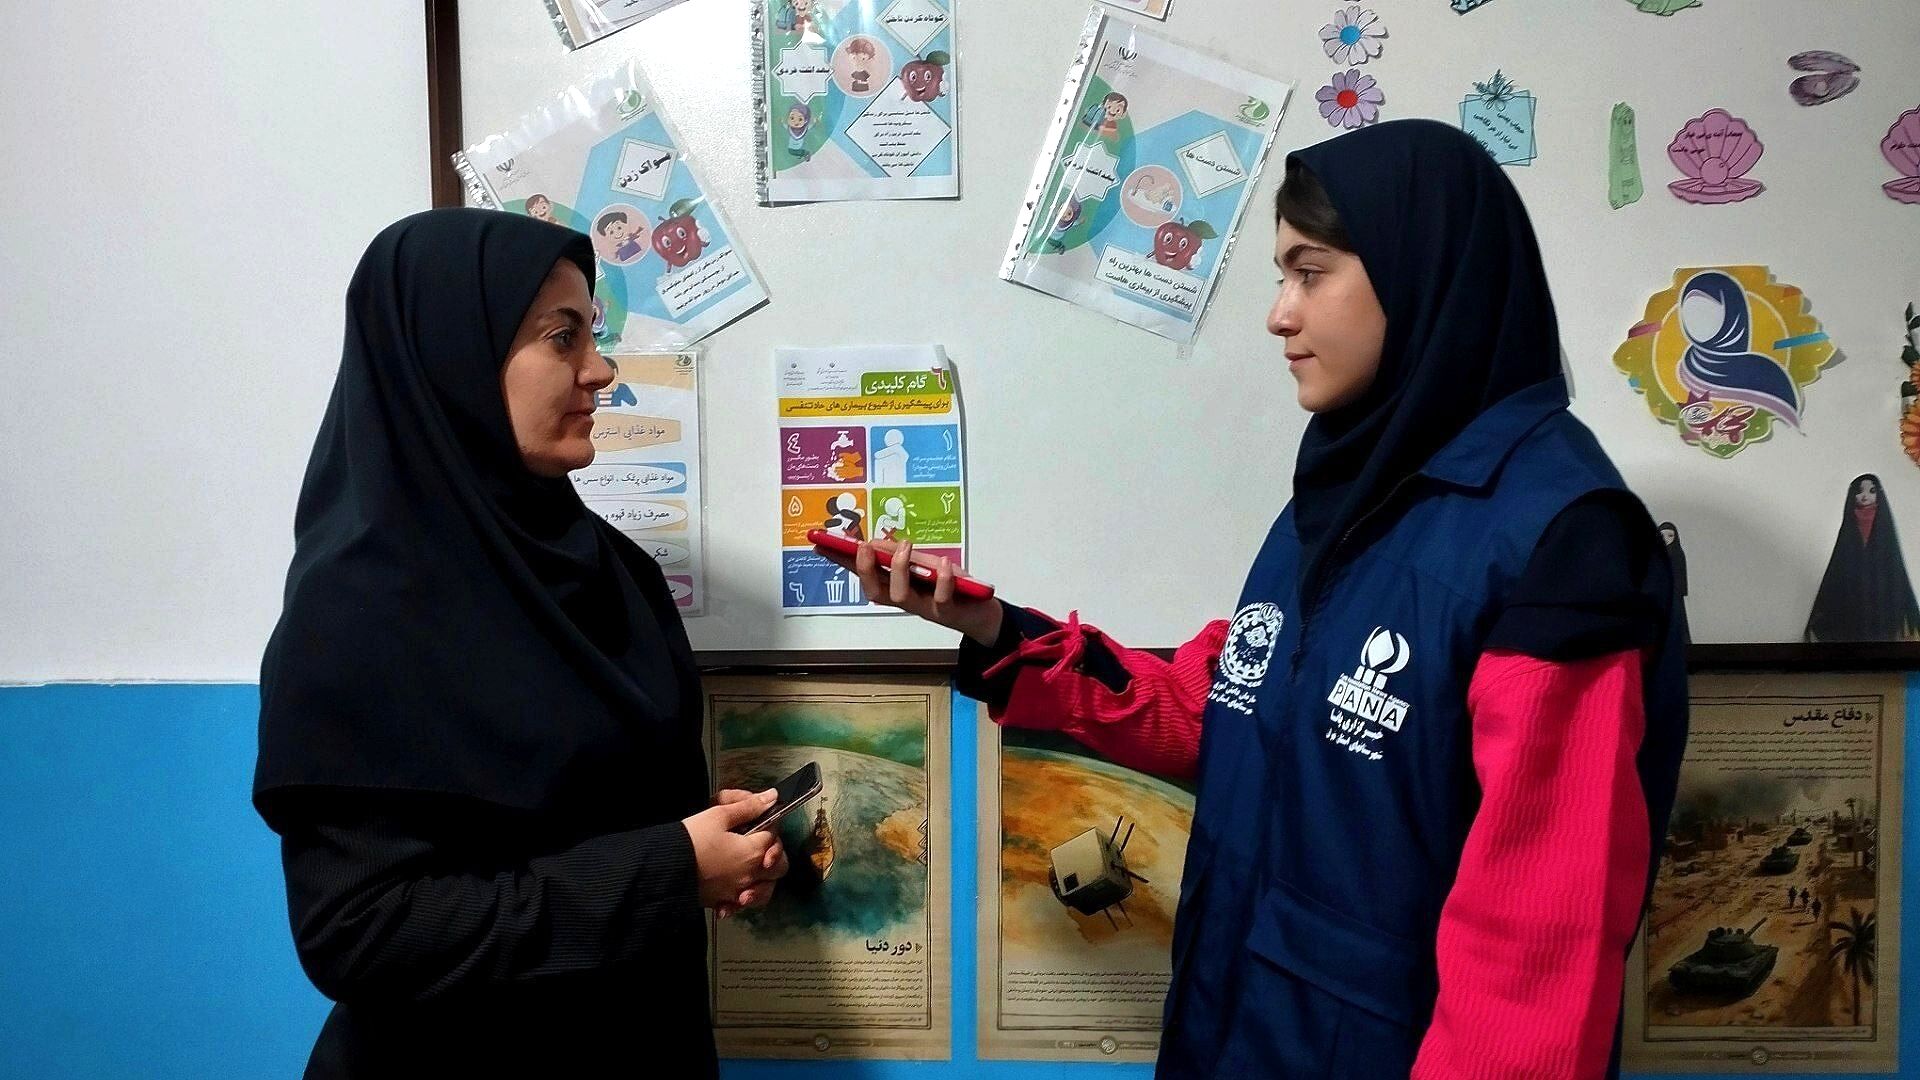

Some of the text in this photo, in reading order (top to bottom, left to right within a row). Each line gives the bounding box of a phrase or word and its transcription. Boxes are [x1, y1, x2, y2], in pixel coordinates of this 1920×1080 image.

[1186, 149, 1241, 176] شستن دست ها
[1109, 256, 1198, 295] شستن دست ها بهترین راه
[1105, 271, 1193, 311] پیشگیری از بیماری هاست
[864, 375, 906, 395] کلیدی
[907, 371, 928, 393] گام
[786, 402, 814, 413] تنفسی
[826, 402, 841, 413] های
[843, 402, 868, 413] بیماری
[867, 401, 888, 412] شیوع
[895, 399, 934, 411] پیشگیری
[934, 399, 950, 410] برای
[593, 424, 665, 440] مواد غذایی استرس
[573, 474, 581, 483] ها
[600, 473, 615, 486] انواع
[641, 472, 659, 485] غذایی
[661, 473, 674, 483] مواد
[610, 508, 625, 521] قهوه
[627, 508, 642, 521] زیاد
[644, 509, 670, 521] مصرف
[1332, 683, 1399, 728] PANA
[1783, 707, 1862, 728] دفاع مقدس
[865, 939, 913, 955] دور دنیا
